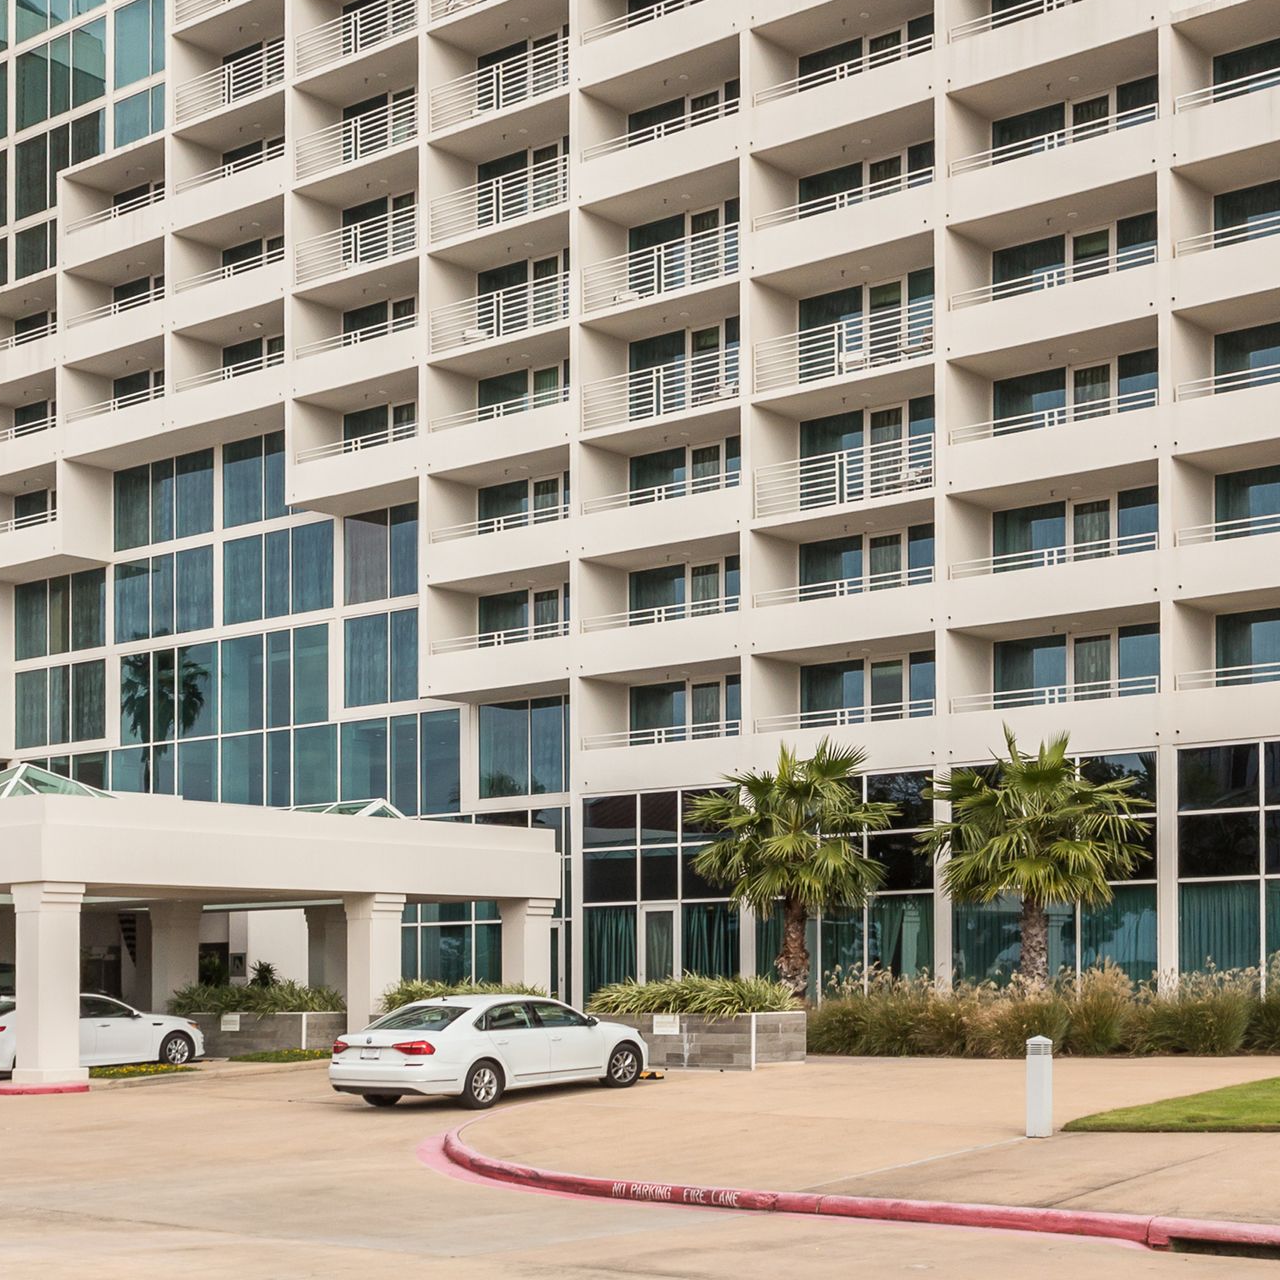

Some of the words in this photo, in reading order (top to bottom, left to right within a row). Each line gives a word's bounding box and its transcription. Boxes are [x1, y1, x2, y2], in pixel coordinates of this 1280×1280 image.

[612, 1182, 626, 1197] NO
[630, 1183, 672, 1200] PARKING
[683, 1188, 707, 1203] FIRE
[711, 1189, 741, 1207] LANE
